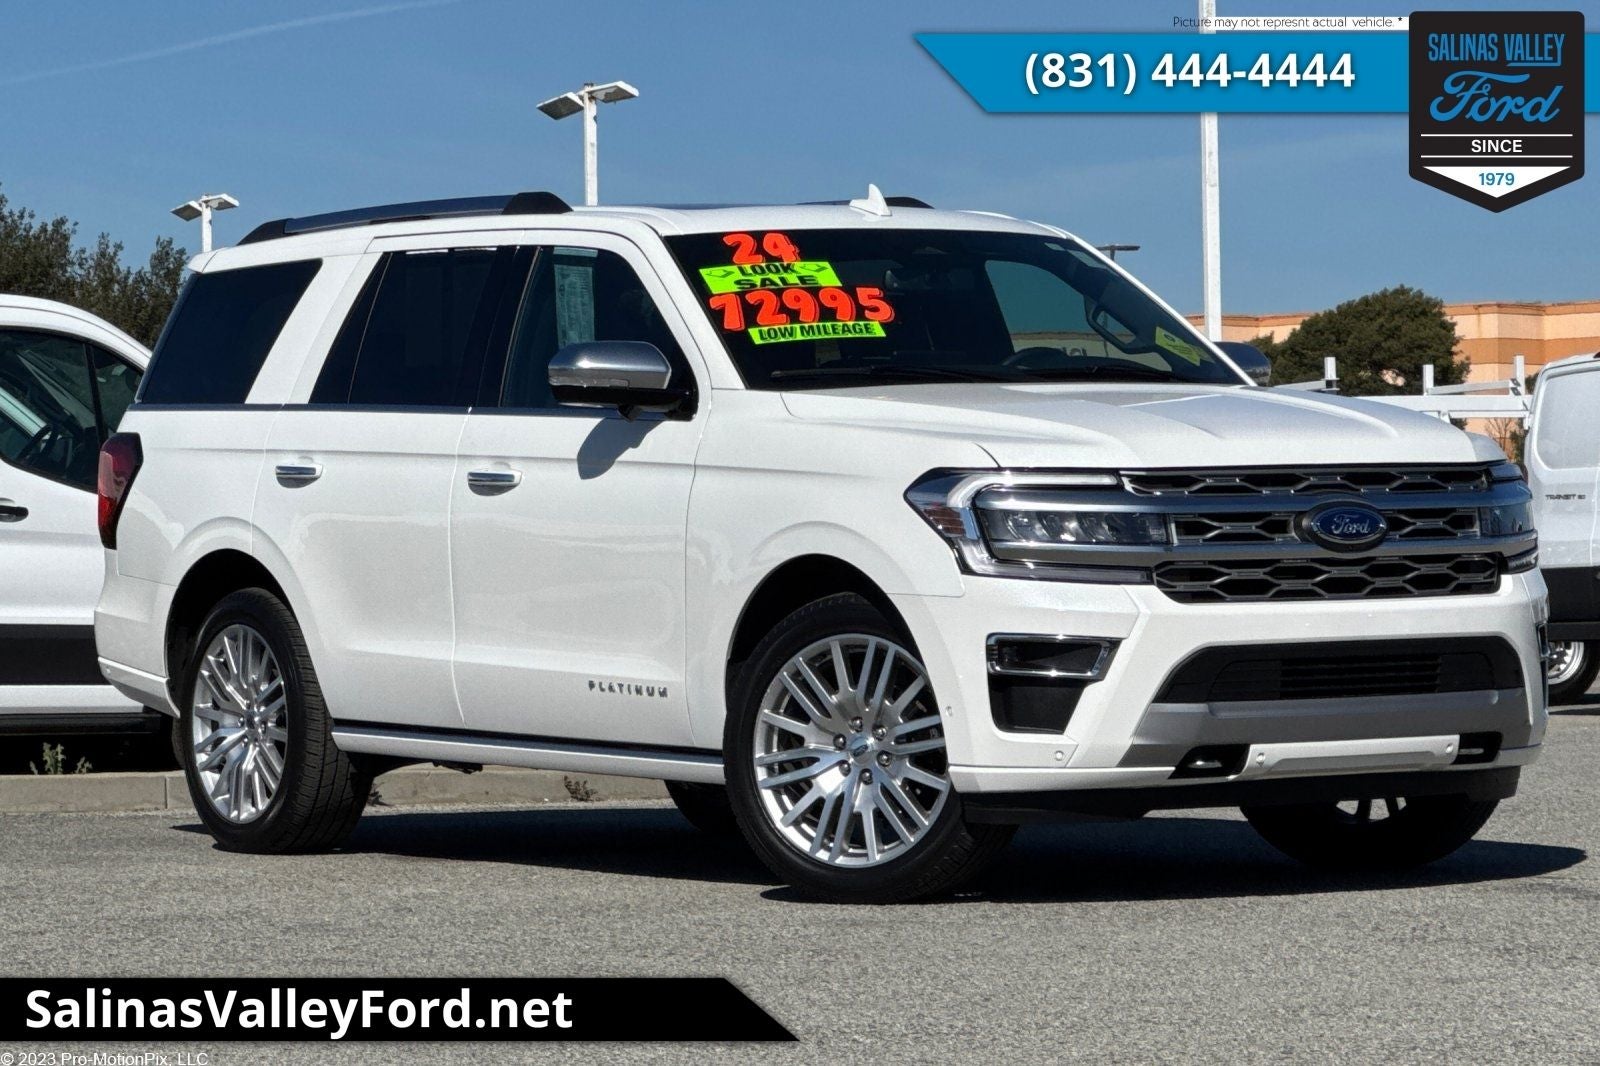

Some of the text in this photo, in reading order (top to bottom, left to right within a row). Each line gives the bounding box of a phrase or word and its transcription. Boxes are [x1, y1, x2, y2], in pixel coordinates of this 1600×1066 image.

[723, 232, 801, 265] 24
[738, 263, 797, 277] LOOK
[733, 274, 820, 291] SALE
[709, 286, 895, 332] 72995
[758, 321, 878, 342] LOW MILEAGE
[1331, 513, 1372, 535] Ford
[588, 679, 668, 698] PLATINUM
